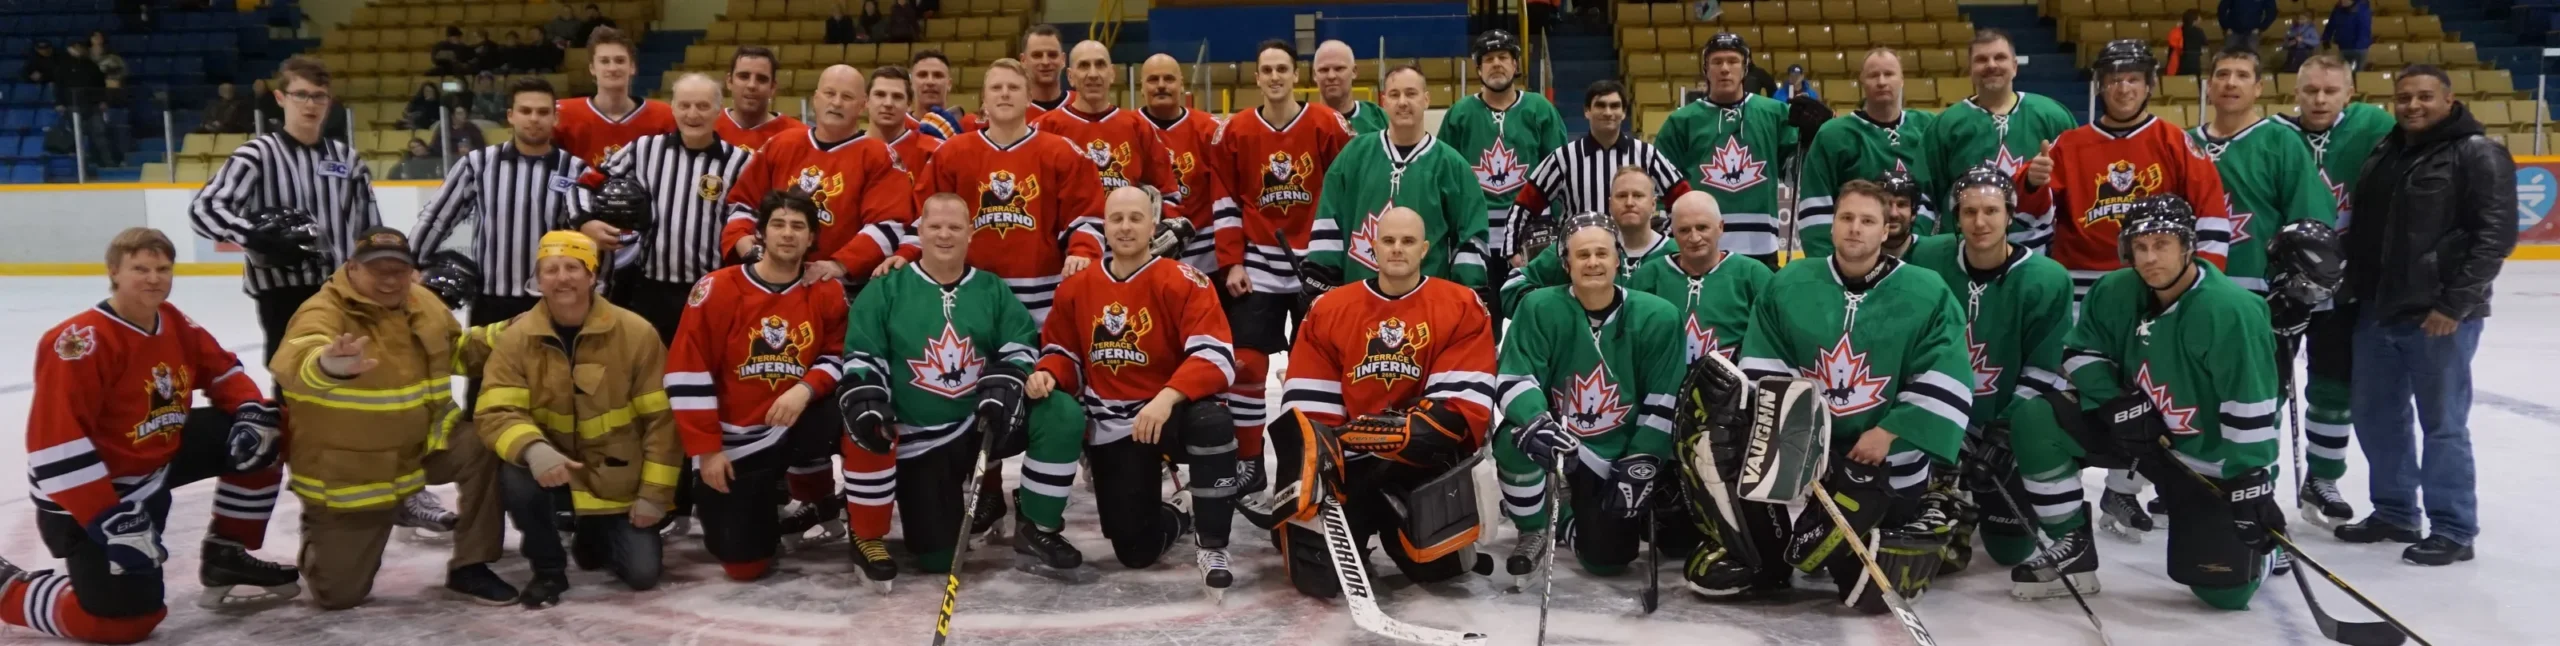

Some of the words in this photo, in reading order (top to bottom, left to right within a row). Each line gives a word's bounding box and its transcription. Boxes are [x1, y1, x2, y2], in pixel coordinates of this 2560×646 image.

[1266, 184, 1299, 193] TERRACE
[1259, 190, 1310, 206] INFERNO
[2098, 196, 2136, 205] TERRAC
[982, 205, 1021, 214] TERRACE
[2088, 203, 2131, 222] INFER
[974, 212, 1033, 228] INFERNO
[1094, 341, 1132, 350] TERRACE
[751, 354, 794, 363] TERRACE
[1090, 348, 1145, 363] INFERNO
[1368, 353, 1409, 363] TERRACE
[741, 362, 805, 377] INFERNO
[1356, 361, 1421, 378] INFERNO
[1742, 388, 1777, 484] VAUGHN
[1325, 504, 1368, 599] WARRIOR
[937, 574, 960, 637] CCM
